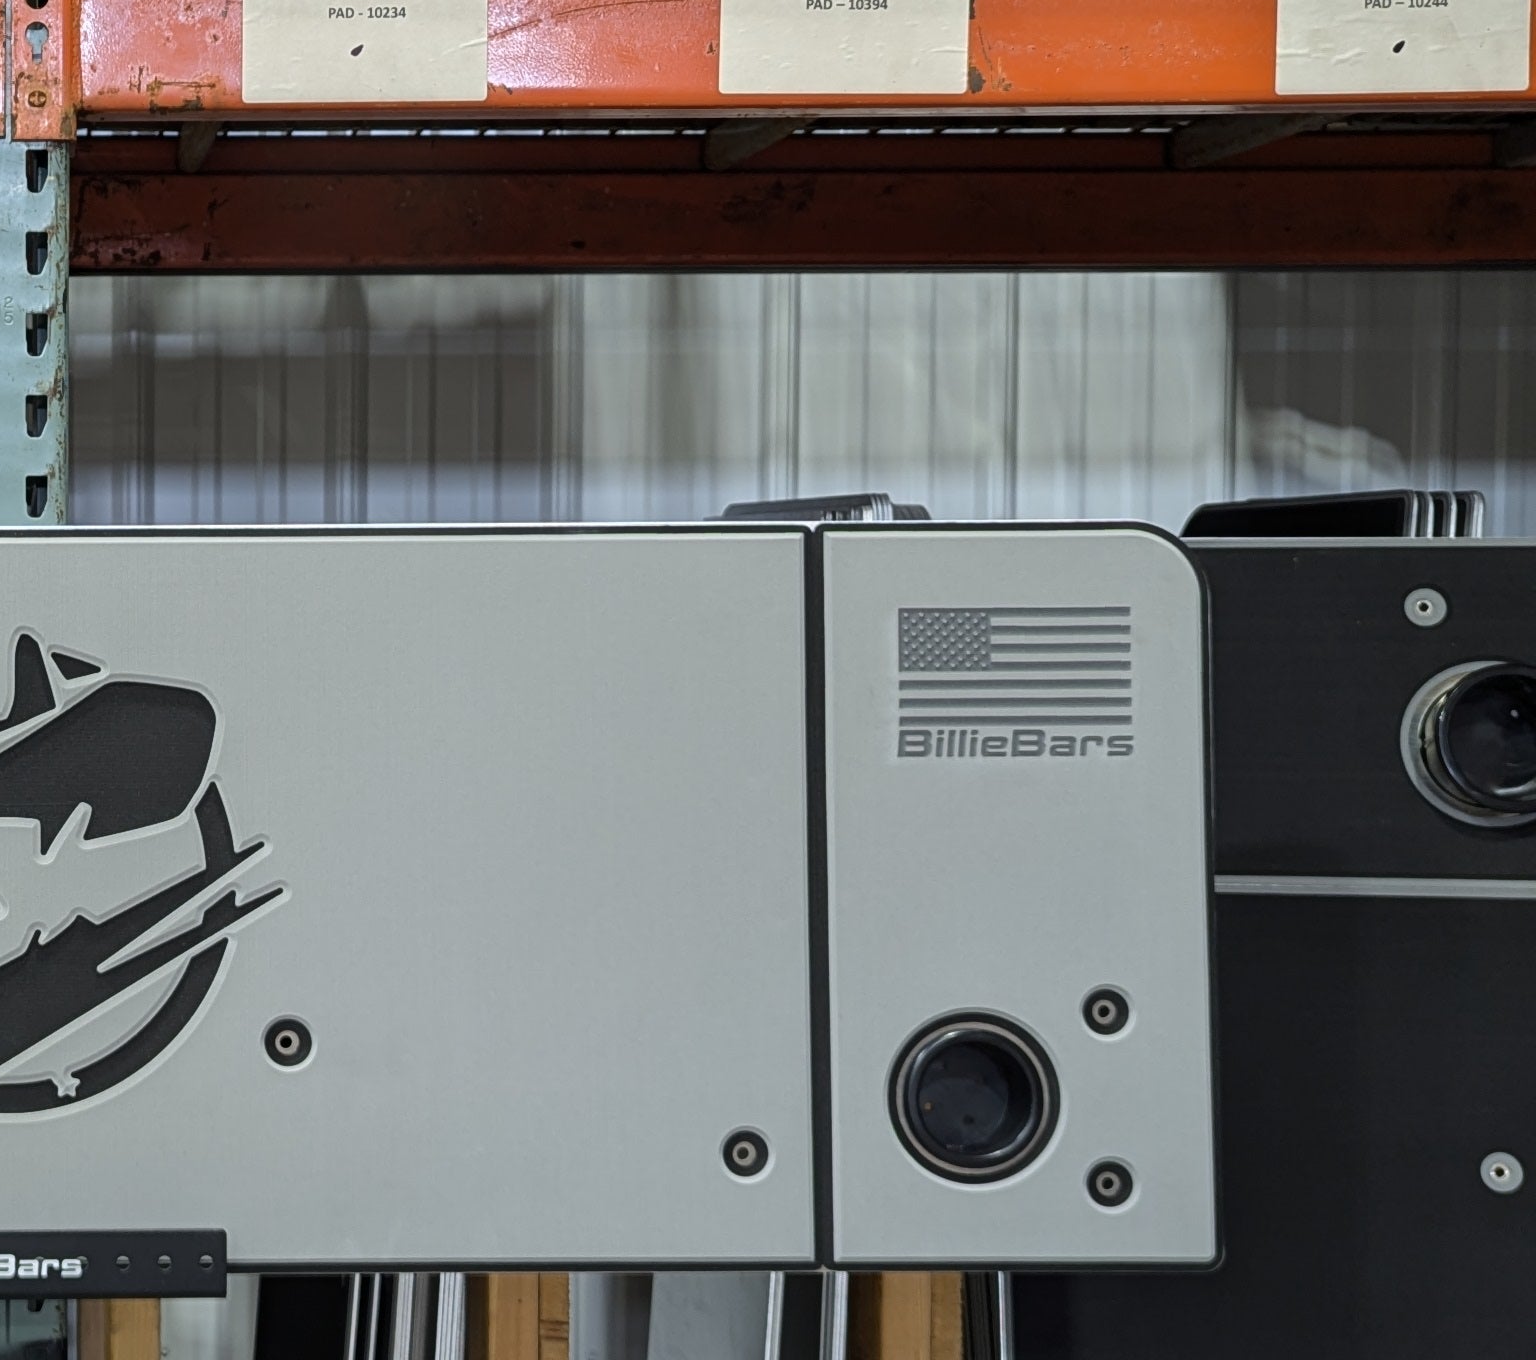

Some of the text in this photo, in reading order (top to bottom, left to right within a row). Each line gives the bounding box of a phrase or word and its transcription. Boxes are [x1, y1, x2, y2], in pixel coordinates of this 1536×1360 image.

[806, 0, 833, 10] PAD
[848, 0, 888, 10] 10394
[328, 7, 355, 19] PAD
[367, 7, 406, 19] 10234
[897, 729, 1135, 758] BillieBars
